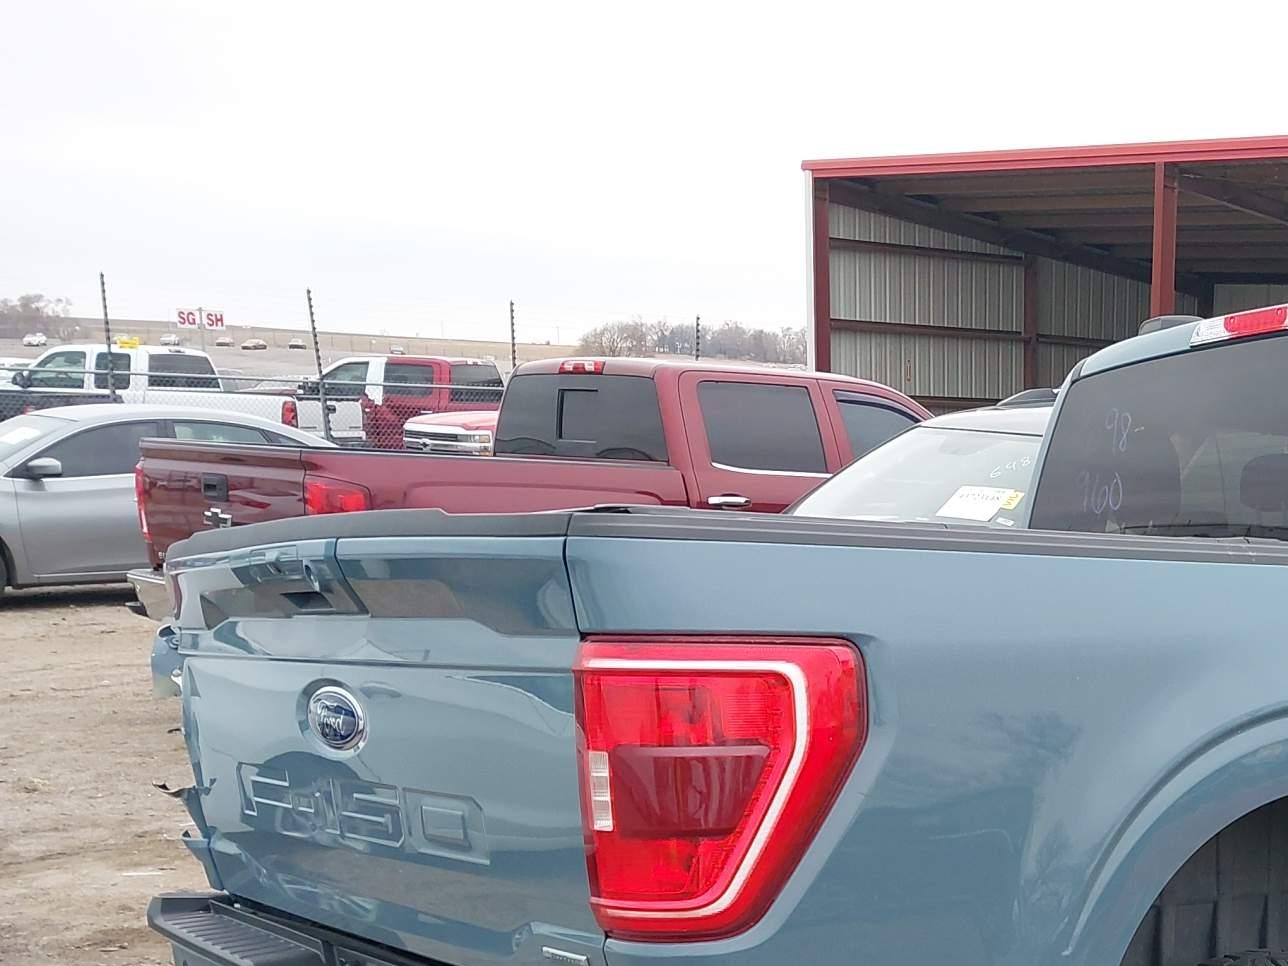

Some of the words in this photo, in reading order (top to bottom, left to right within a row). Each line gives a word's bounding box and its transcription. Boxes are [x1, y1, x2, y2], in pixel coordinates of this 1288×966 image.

[177, 311, 196, 326] SG
[206, 313, 225, 327] SH
[314, 698, 346, 734] Ford
[235, 760, 492, 867] F-150
